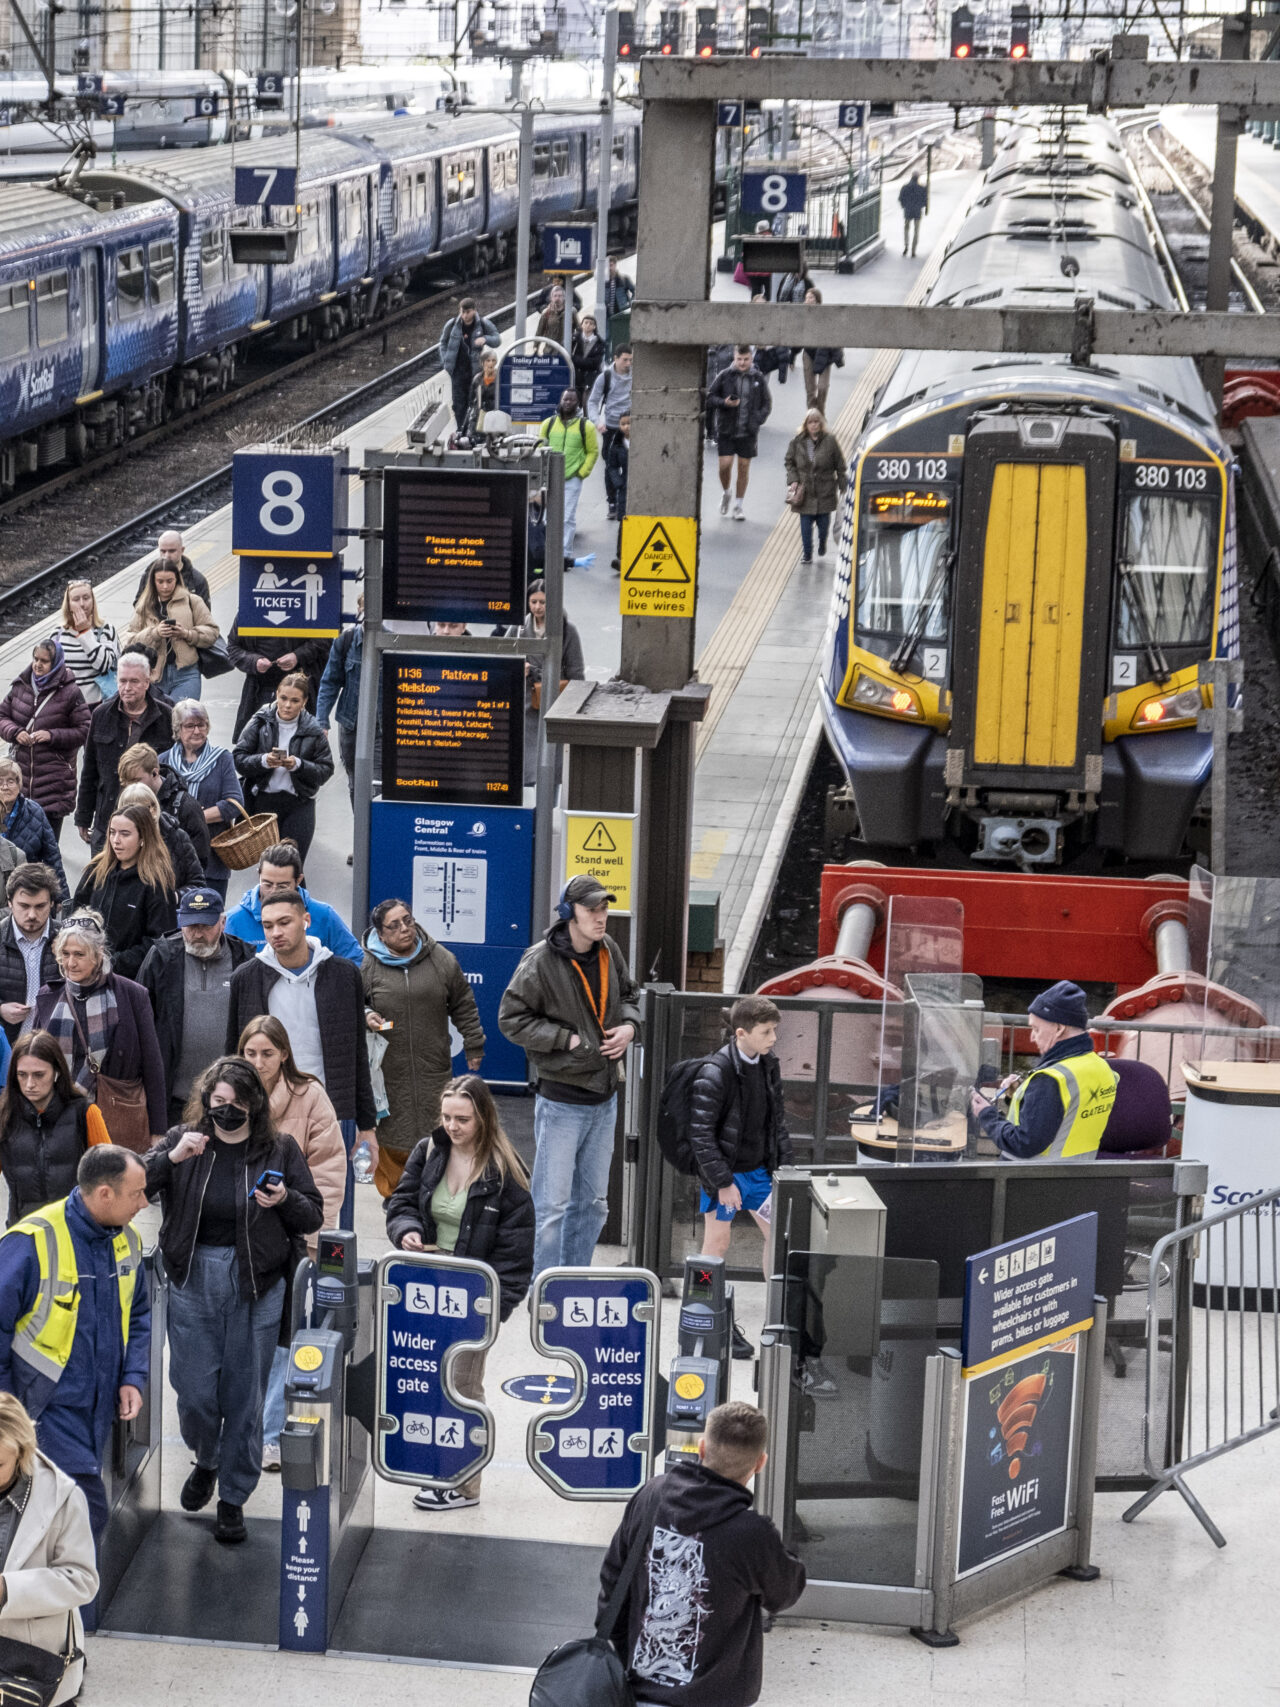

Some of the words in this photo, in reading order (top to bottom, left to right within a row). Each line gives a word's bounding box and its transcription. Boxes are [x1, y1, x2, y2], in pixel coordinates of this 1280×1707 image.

[85, 77, 95, 90] 5
[264, 76, 275, 92] 6
[107, 98, 118, 112] 5
[200, 97, 213, 113] 6
[723, 105, 737, 124] 7
[844, 106, 858, 125] 8
[253, 169, 278, 204] 7
[761, 174, 788, 212] 8
[512, 357, 532, 365] Trolley
[877, 459, 910, 480] 380
[915, 459, 947, 480] 103
[1135, 465, 1169, 488] 380
[1175, 467, 1207, 490] 103
[259, 469, 305, 535] 8
[425, 535, 456, 544] Please
[458, 537, 485, 546] check
[434, 546, 476, 556] timetable
[644, 552, 673, 560] DANGER
[444, 558, 484, 567] services
[628, 587, 687, 599] Overhead
[253, 596, 302, 609] TICKETS
[627, 599, 648, 610] live
[653, 601, 686, 611] wires
[928, 654, 941, 672] 2
[1119, 661, 1131, 679] 2
[397, 667, 422, 679] 11:36
[441, 669, 479, 681] Platform
[481, 671, 489, 681] 8
[477, 700, 491, 709] Page
[414, 817, 454, 827] Glasgow
[414, 825, 449, 834] Central
[575, 854, 602, 864] Stand
[604, 856, 624, 865] well
[587, 867, 610, 877] clear
[993, 1287, 1013, 1303] Wider
[1015, 1280, 1037, 1295] access
[1038, 1272, 1054, 1288] gate
[992, 1297, 1022, 1319] available
[1023, 1293, 1033, 1307] for
[1034, 1282, 1070, 1301] customers
[1071, 1276, 1078, 1289] in
[992, 1310, 1032, 1334] wheelchairs
[1033, 1308, 1041, 1318] or
[1042, 1298, 1058, 1314] with
[991, 1333, 1013, 1352] prams,
[1015, 1322, 1034, 1340] bikes
[1034, 1320, 1042, 1331] or
[1043, 1310, 1070, 1329] luggage
[392, 1330, 436, 1350] Wider
[595, 1347, 641, 1363] Wider
[389, 1355, 438, 1373] access
[397, 1377, 429, 1394] gate
[591, 1372, 642, 1385] access
[599, 1394, 633, 1410] gate
[991, 1493, 1006, 1507] Fast
[1006, 1477, 1040, 1512] WiFi
[990, 1506, 1005, 1520] Free
[291, 1555, 315, 1565] Please
[285, 1562, 303, 1574] keep
[303, 1567, 320, 1575] your
[287, 1573, 318, 1582] distance
